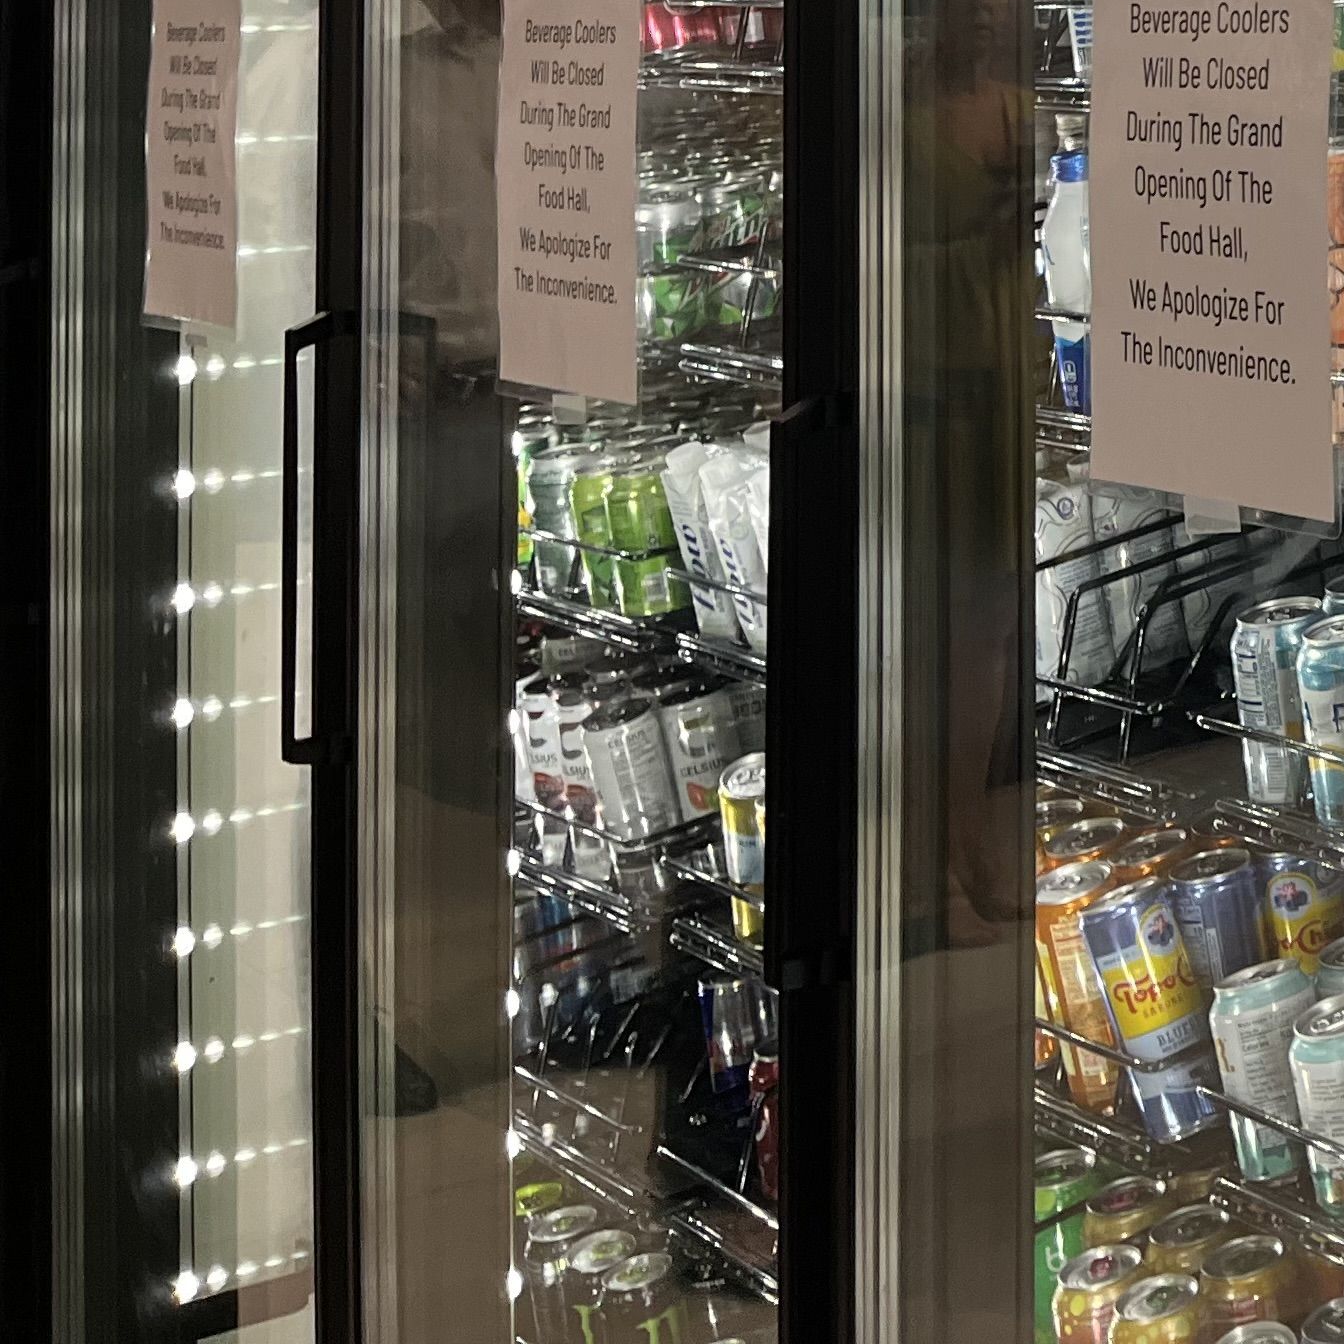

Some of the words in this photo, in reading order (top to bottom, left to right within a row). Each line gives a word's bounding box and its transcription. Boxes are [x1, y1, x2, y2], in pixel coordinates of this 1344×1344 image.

[526, 19, 572, 49] Beverage
[575, 20, 616, 43] Coolers
[1131, 4, 1210, 41] Beverage
[1218, 2, 1289, 33] Coolers
[532, 61, 549, 82] Will
[552, 61, 565, 84] Be
[568, 61, 604, 85] Closed
[1143, 57, 1173, 87] Will
[1179, 58, 1200, 88] Be
[1207, 58, 1269, 89] Closed
[521, 101, 554, 131] During
[557, 102, 576, 127] The
[579, 104, 611, 128] Grand
[1127, 111, 1182, 151] During
[1189, 113, 1221, 145] The
[1228, 114, 1282, 147] Grand
[525, 142, 566, 174] Opening
[570, 145, 581, 169] Of
[585, 146, 604, 171] The
[539, 184, 564, 209] Food
[1135, 166, 1206, 208] Opening
[1213, 170, 1231, 201] Of
[1238, 171, 1272, 204] The
[520, 228, 536, 251] We
[539, 230, 590, 262] Apologize
[594, 235, 611, 260] For
[1161, 222, 1203, 255] Food
[1209, 226, 1247, 261] Hall,
[514, 267, 533, 292] The
[1130, 279, 1156, 311] We
[1162, 282, 1248, 326] Apologize
[1255, 291, 1284, 324] For
[1121, 332, 1152, 365] The
[1159, 336, 1295, 384] Inconvenience.
